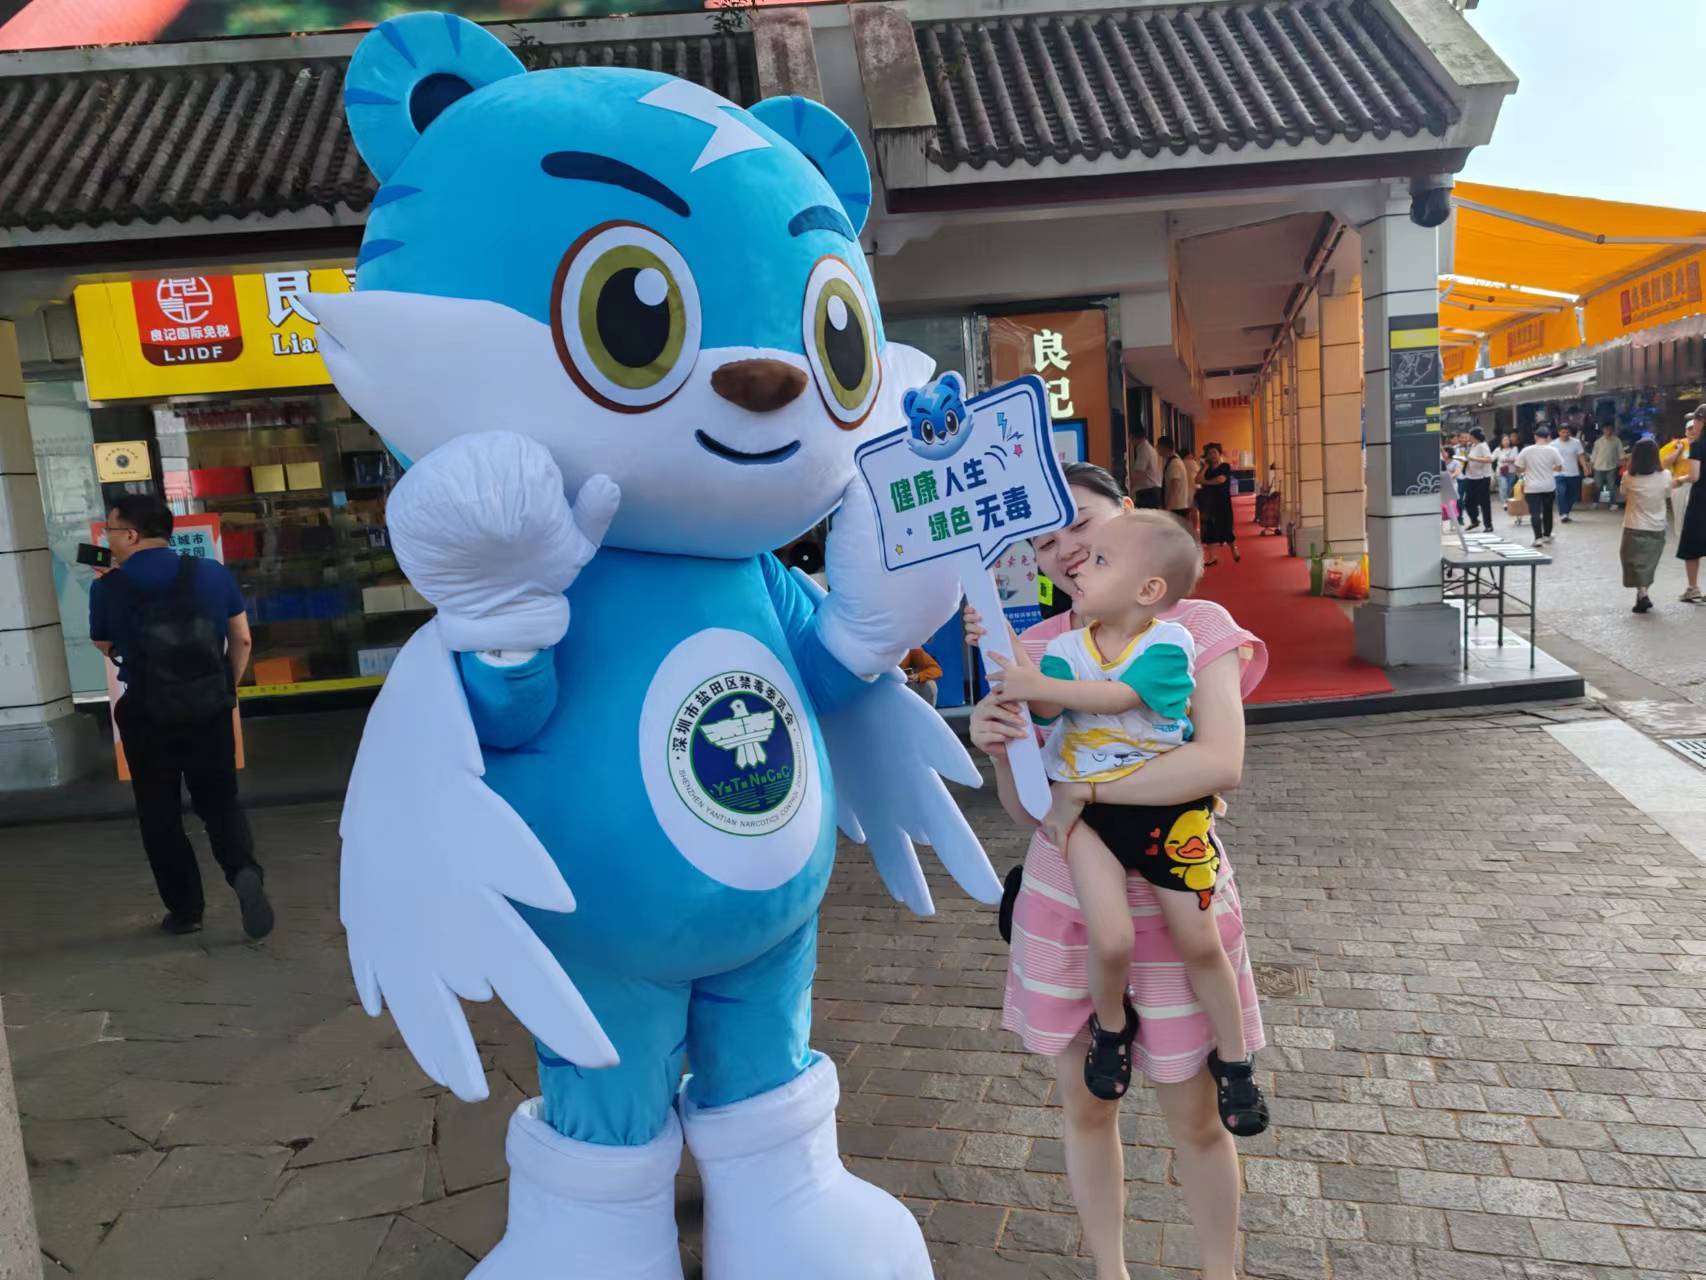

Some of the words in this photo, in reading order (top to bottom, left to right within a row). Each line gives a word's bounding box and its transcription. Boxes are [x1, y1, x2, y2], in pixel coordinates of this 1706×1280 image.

[150, 324, 230, 342] 良记国际免税
[163, 345, 223, 363] LJIDF
[272, 332, 320, 356] Lia
[1033, 328, 1074, 419] 良记
[889, 457, 987, 513] 健康人生
[927, 485, 1032, 542] 绿色无毒
[672, 675, 794, 753] 深圳市盐田区禁毒委员会
[678, 768, 705, 809] SHENZHEN
[705, 806, 738, 827] YANTIAN
